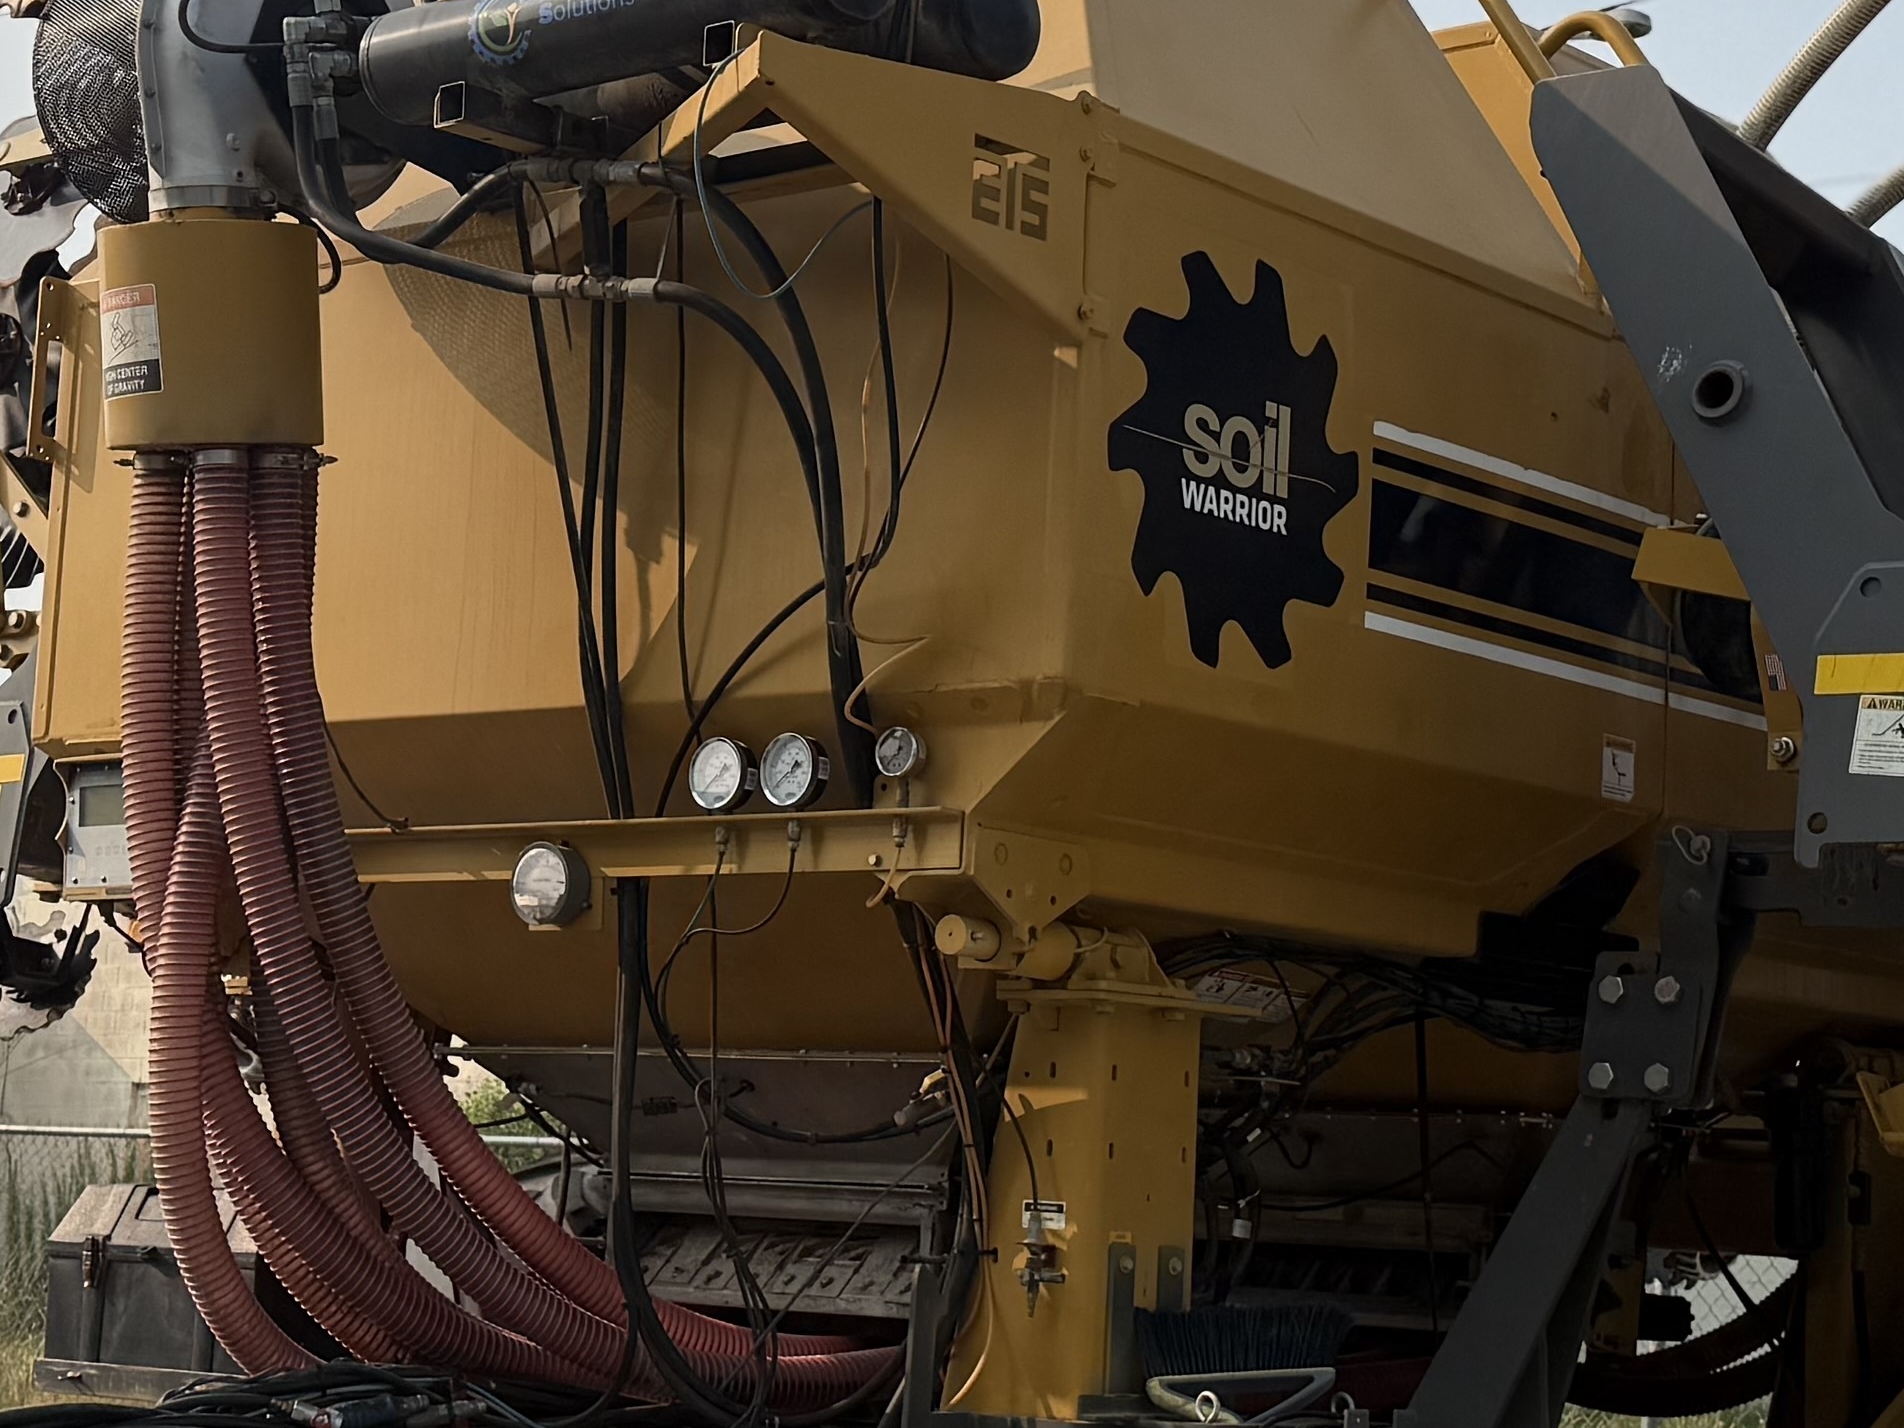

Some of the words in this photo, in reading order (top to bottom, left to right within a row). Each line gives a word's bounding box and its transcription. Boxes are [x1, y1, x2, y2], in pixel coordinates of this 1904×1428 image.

[971, 132, 1050, 242] ETS
[114, 379, 145, 394] GRAVITY
[1182, 400, 1292, 499] soil
[1181, 477, 1288, 535] WARRIOR
